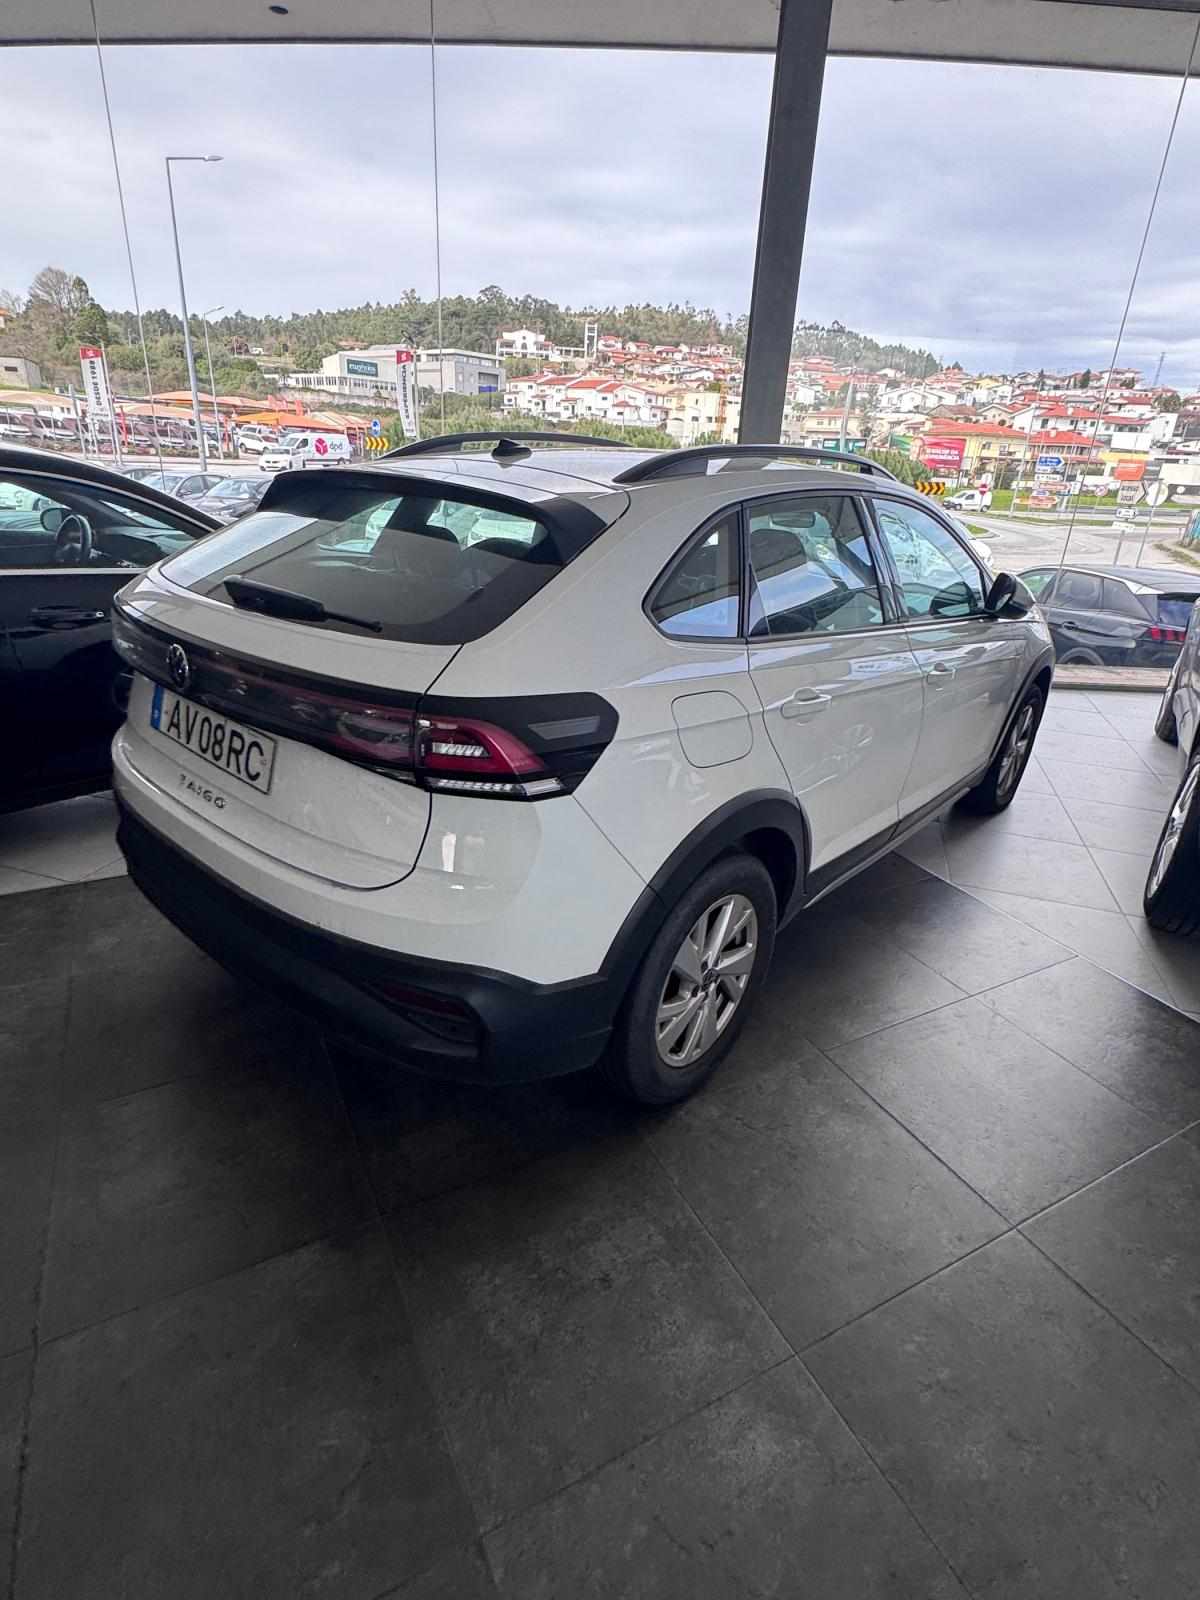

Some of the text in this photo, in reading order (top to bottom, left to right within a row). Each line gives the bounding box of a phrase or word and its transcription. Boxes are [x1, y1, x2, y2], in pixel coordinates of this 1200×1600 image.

[93, 381, 103, 406] DESDE
[329, 442, 343, 452] dpd
[179, 773, 226, 809] TAIGO
